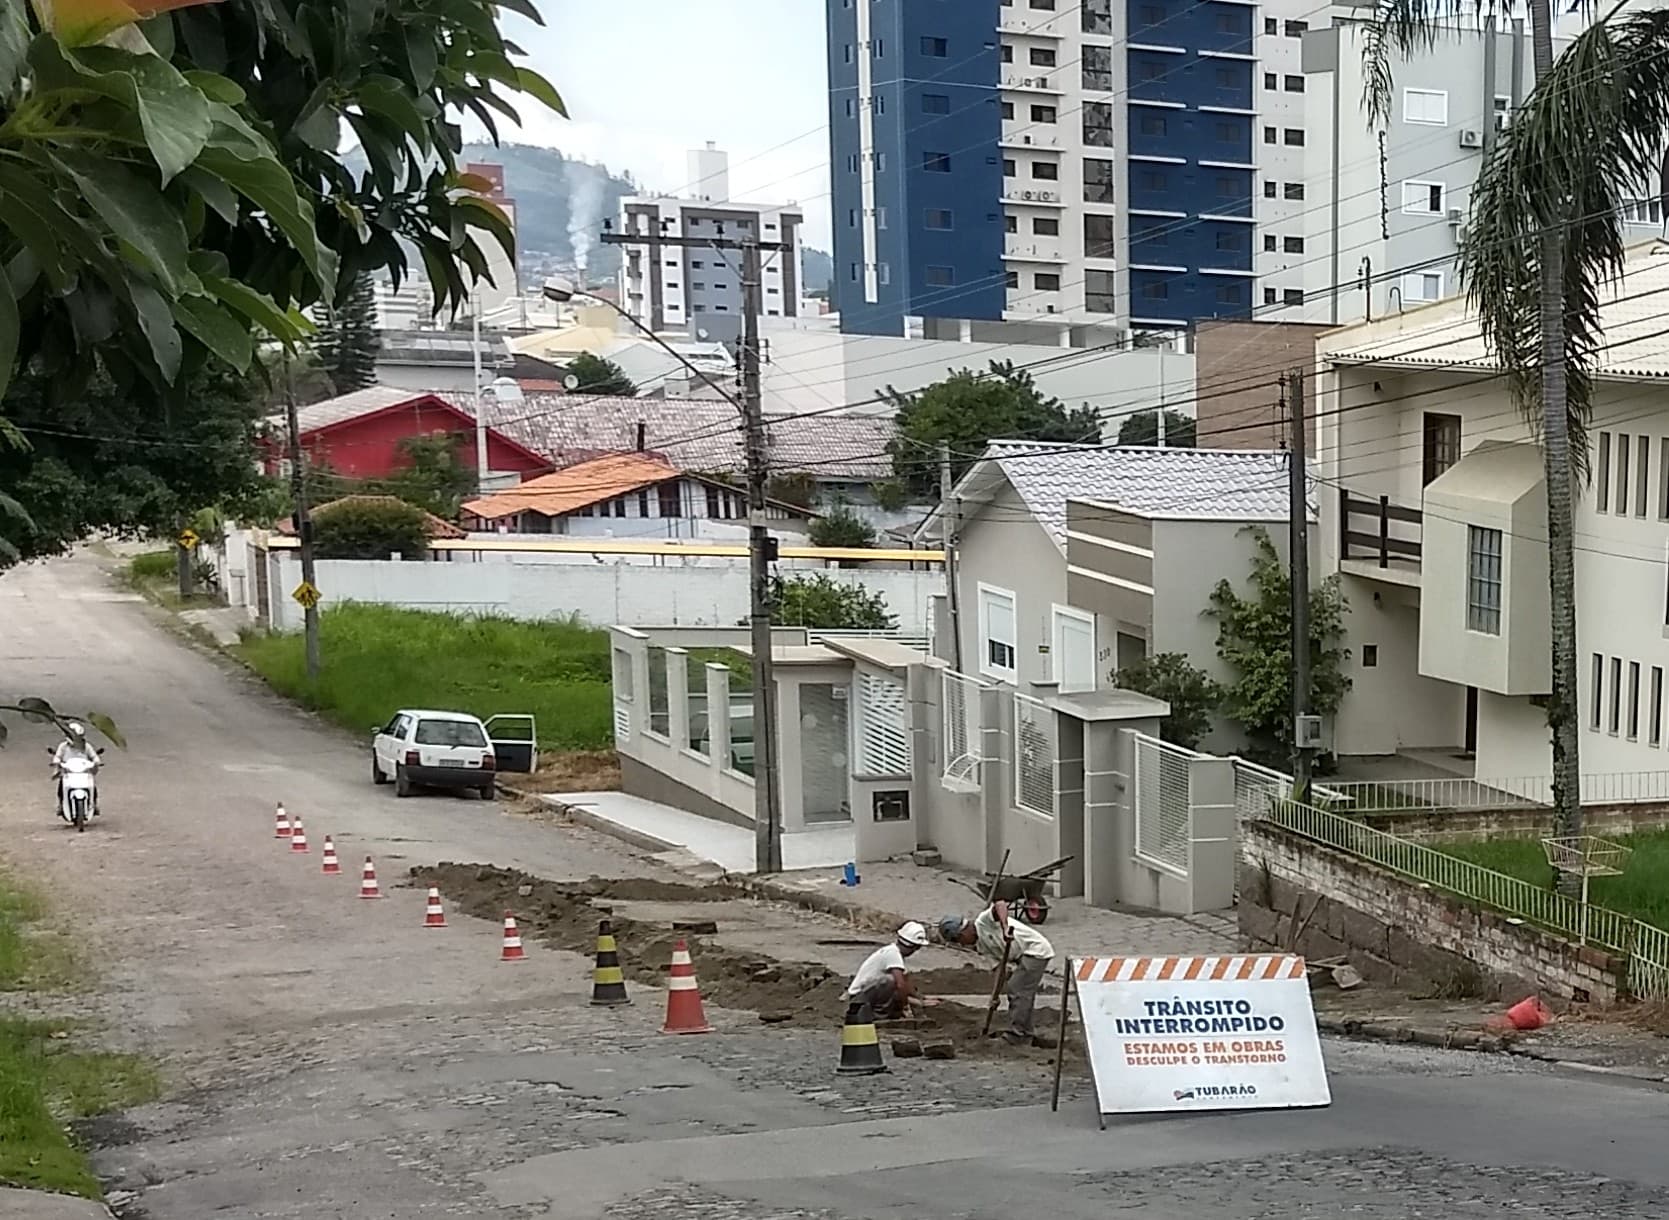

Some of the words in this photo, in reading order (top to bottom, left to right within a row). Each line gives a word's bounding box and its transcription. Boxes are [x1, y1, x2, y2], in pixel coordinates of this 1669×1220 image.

[1144, 996, 1251, 1016] TRÂNSITO
[1115, 1016, 1285, 1034] INTERROMPIDO
[1124, 1043, 1198, 1055] ESTAMOS
[1203, 1042, 1227, 1053] EM
[1231, 1040, 1284, 1053] OBRAS
[1126, 1056, 1188, 1066] DESCULPE
[1191, 1055, 1201, 1065] O
[1205, 1054, 1286, 1064] TRANSTORNO
[1195, 1083, 1256, 1096] TUBARÃO
